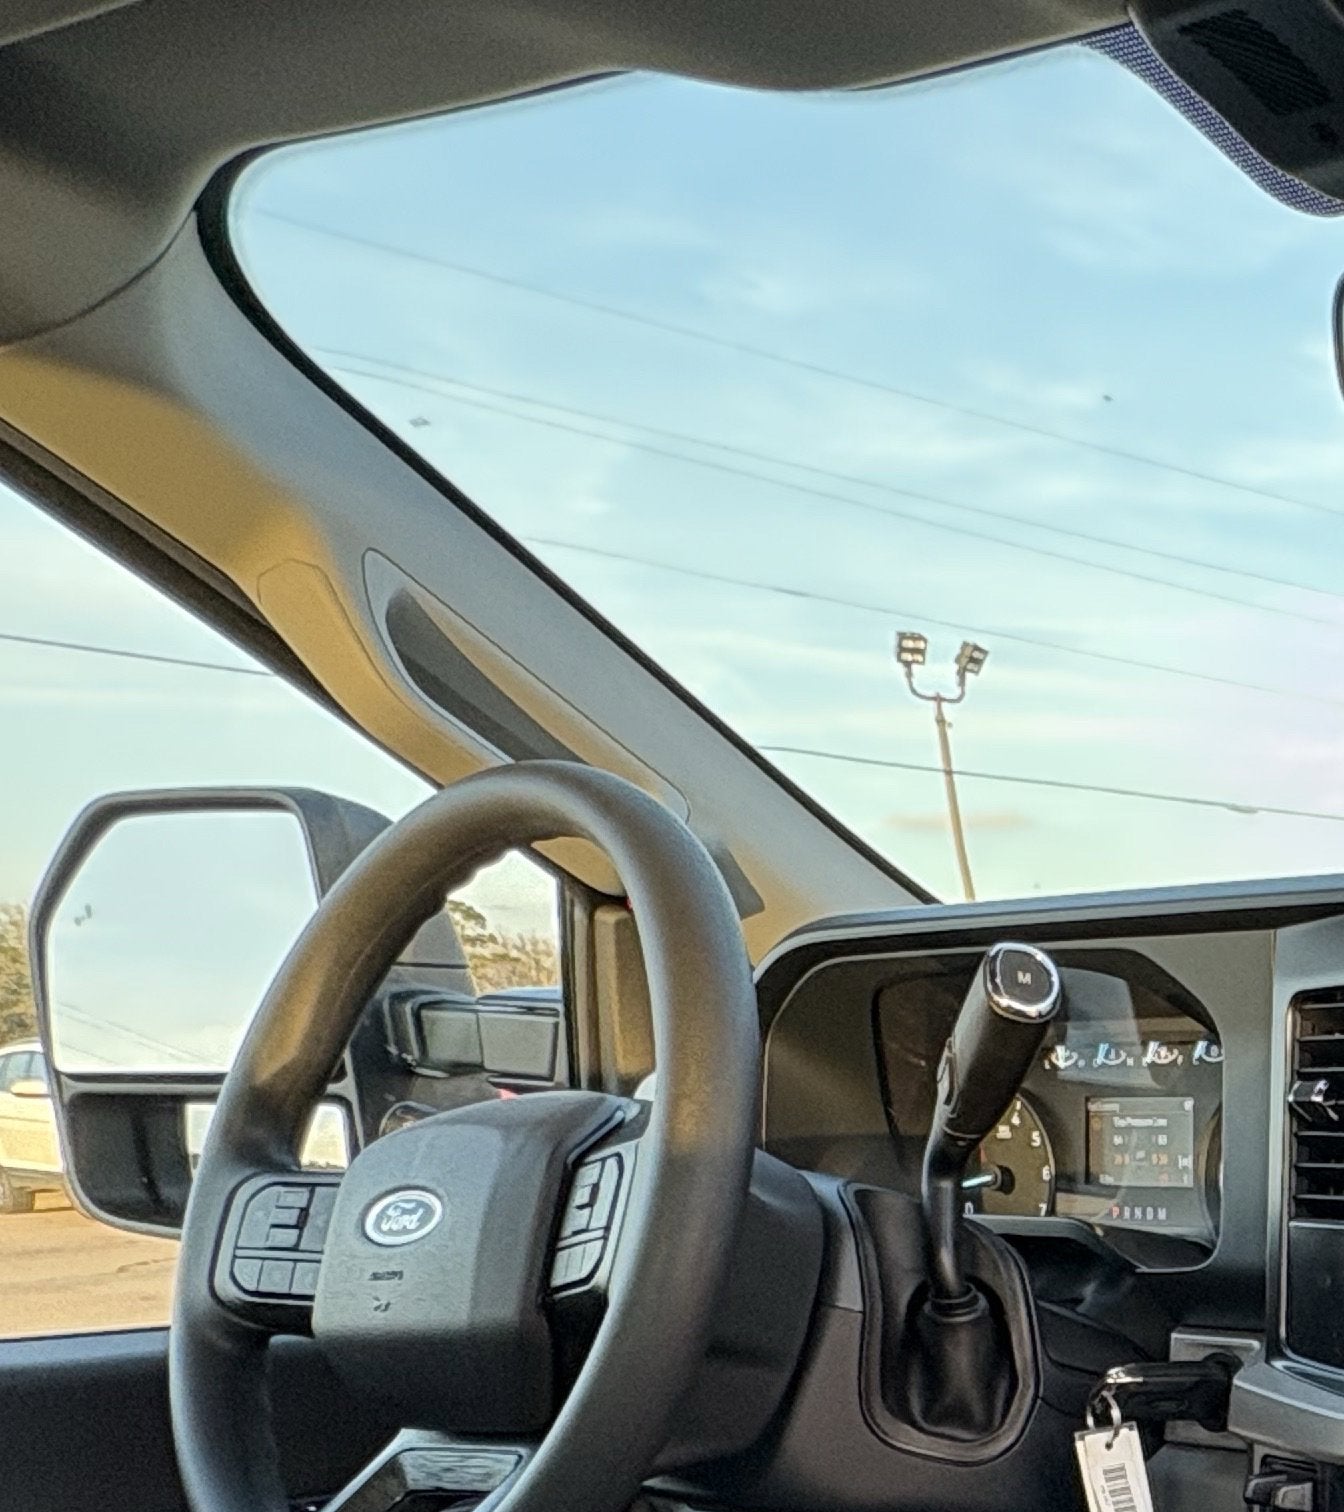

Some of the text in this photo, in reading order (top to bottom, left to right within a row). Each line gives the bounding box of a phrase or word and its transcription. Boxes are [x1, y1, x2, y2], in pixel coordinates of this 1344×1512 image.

[1016, 970, 1032, 985] M
[1031, 1130, 1042, 1148] 5
[1042, 1164, 1051, 1181] 6
[380, 1202, 425, 1232] Ford
[1038, 1202, 1048, 1216] 7
